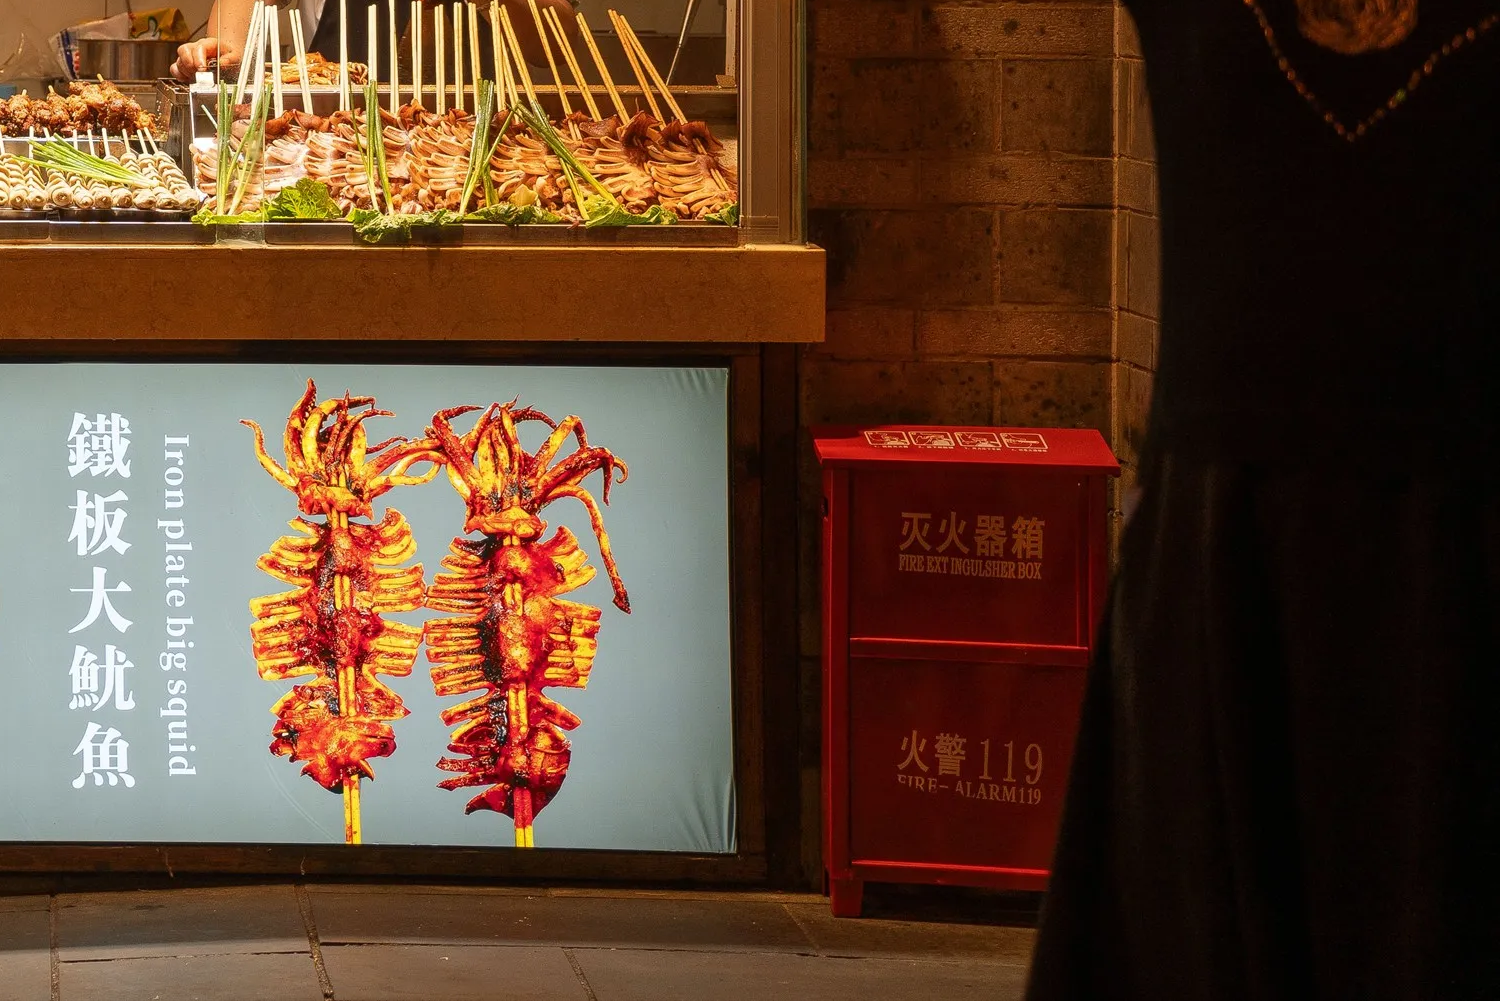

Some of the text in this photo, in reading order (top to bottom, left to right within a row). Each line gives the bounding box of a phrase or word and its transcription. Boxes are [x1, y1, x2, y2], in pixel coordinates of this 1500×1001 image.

[899, 511, 1046, 560] 灭火器箱
[899, 554, 925, 572] FIRE
[1017, 562, 1042, 579] BOX
[67, 412, 136, 789] 鐵板大魷魚
[157, 434, 197, 777] Iron plate big squid
[897, 730, 1044, 785] 火警 119
